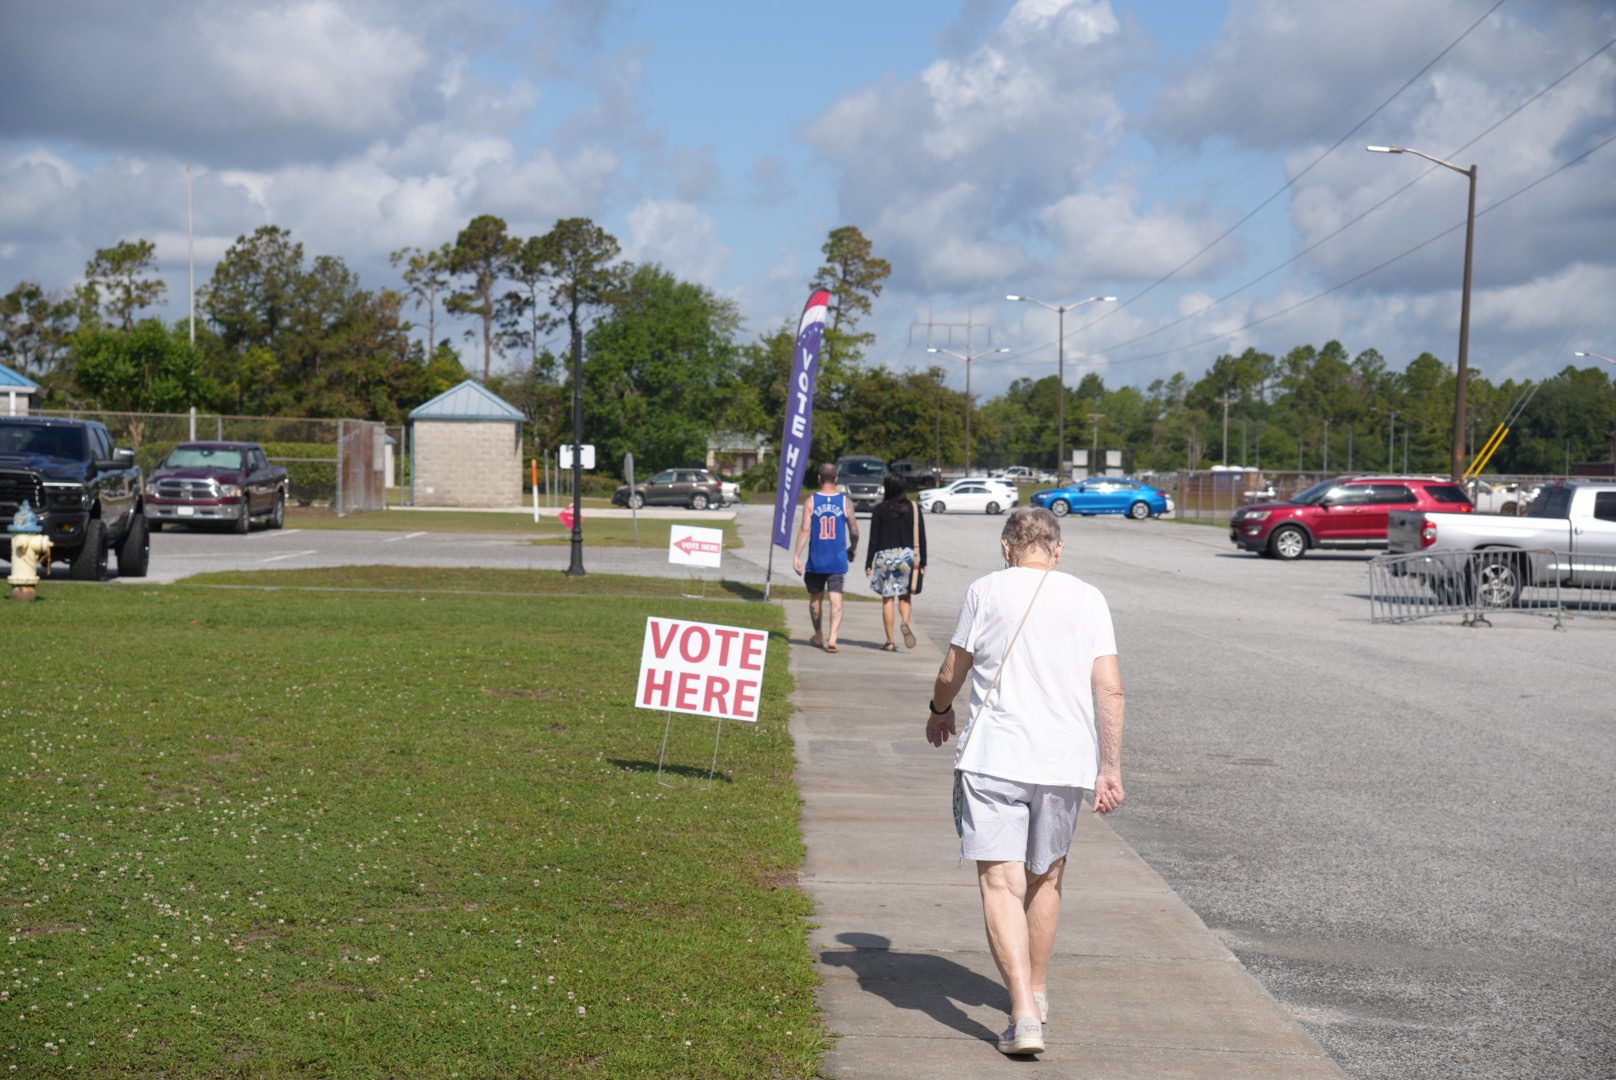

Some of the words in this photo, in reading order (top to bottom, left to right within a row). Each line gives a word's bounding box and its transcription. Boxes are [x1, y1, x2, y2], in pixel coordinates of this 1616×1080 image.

[792, 347, 813, 439] VOTE
[813, 503, 844, 517] BRUNSON
[819, 515, 836, 540] 11
[681, 541, 699, 550] VOTE
[701, 543, 719, 552] HERE
[650, 621, 765, 671] VOTE
[643, 668, 758, 718] HERE
